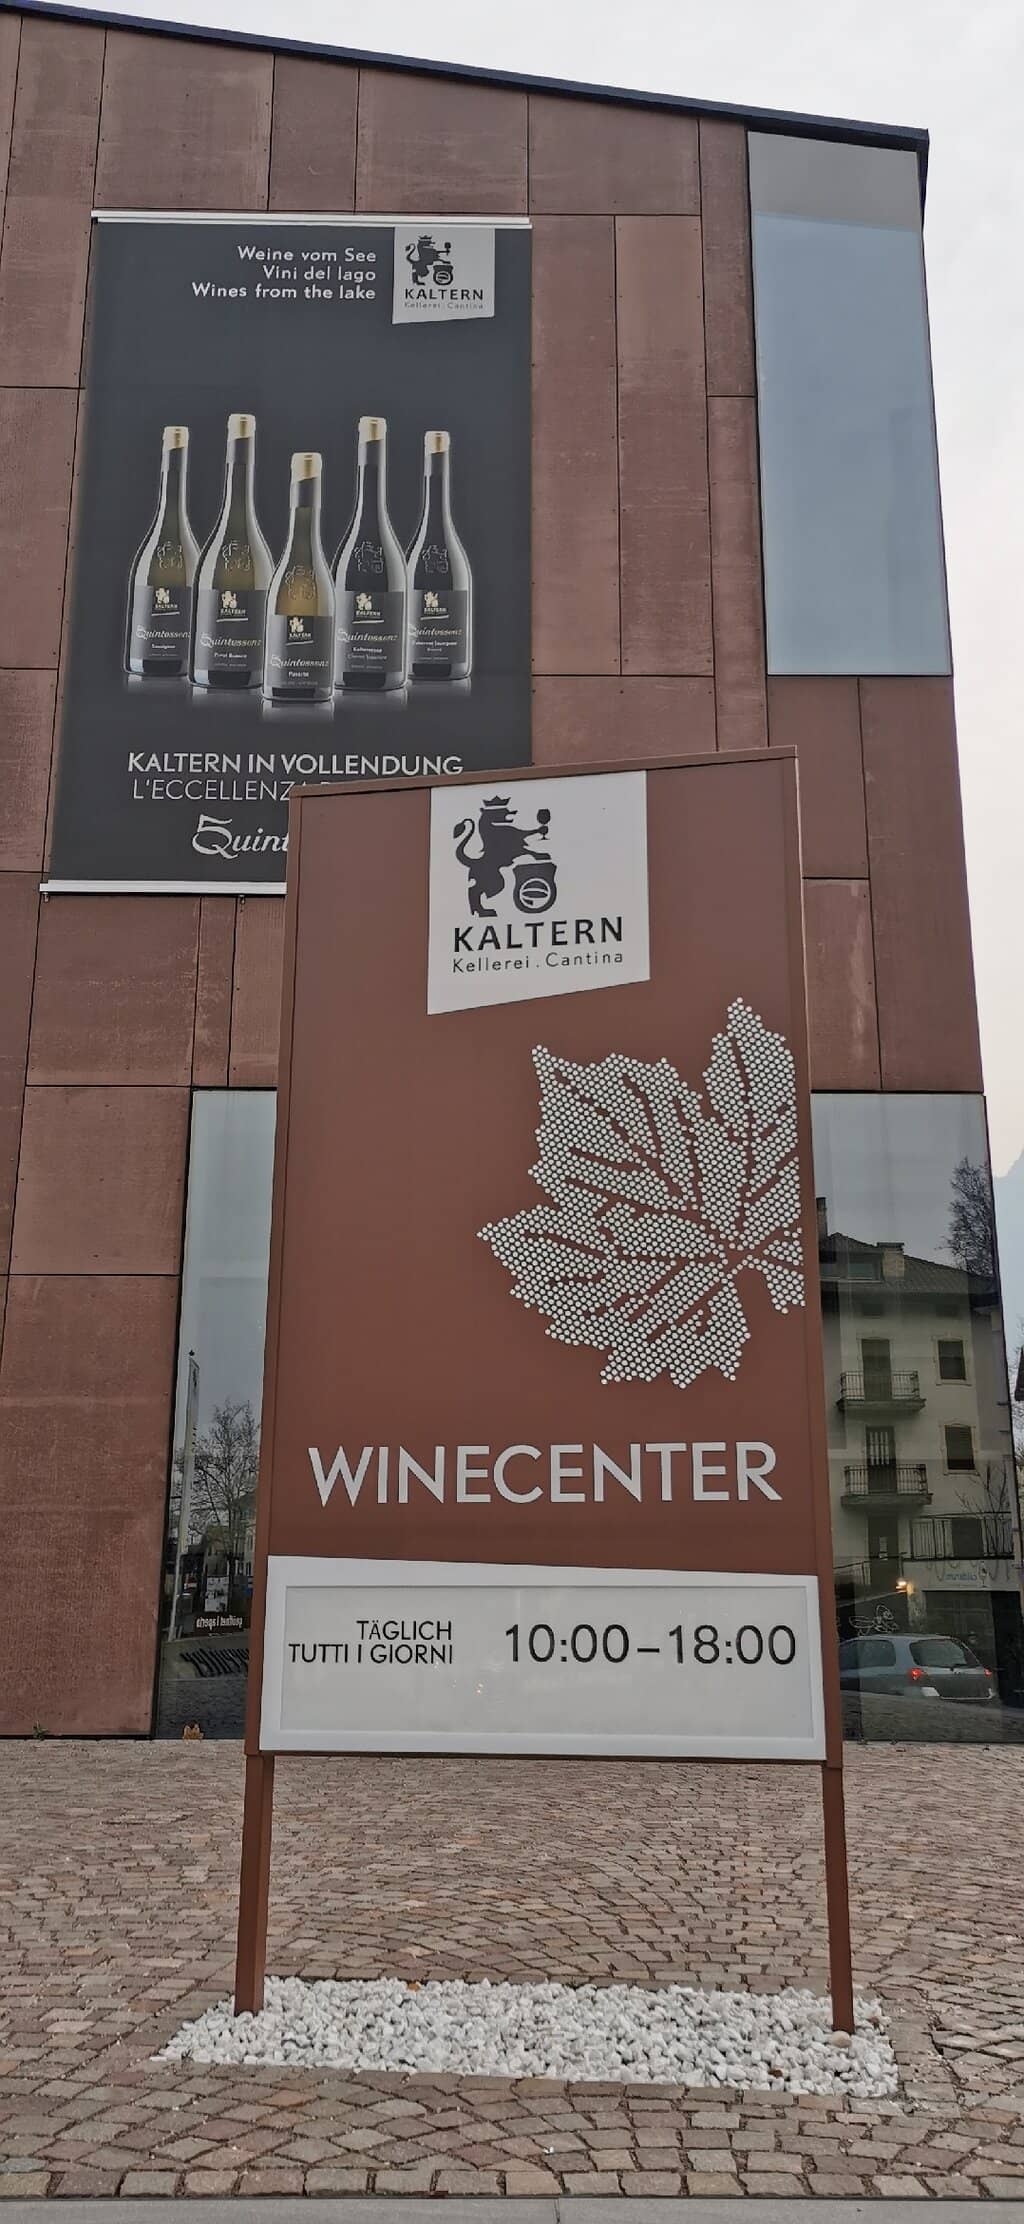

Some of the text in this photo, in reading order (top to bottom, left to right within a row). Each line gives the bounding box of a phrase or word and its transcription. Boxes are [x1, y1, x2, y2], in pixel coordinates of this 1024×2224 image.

[238, 246, 377, 263] Weine vom See
[262, 265, 377, 285] Vini del lago
[191, 282, 377, 300] Wines from the lake
[405, 288, 484, 301] KALTERN
[127, 752, 465, 776] KALTERN IN VOLLENDUNG
[132, 778, 307, 801] L'ECCELLENZ
[453, 916, 623, 953] KALTERN
[452, 956, 530, 974] Kellerei
[545, 952, 624, 968] Cantina
[308, 1441, 783, 1507] WINECENTER
[356, 1620, 452, 1641] TÄGLICH
[288, 1643, 453, 1664] TUTTI I GIORNI
